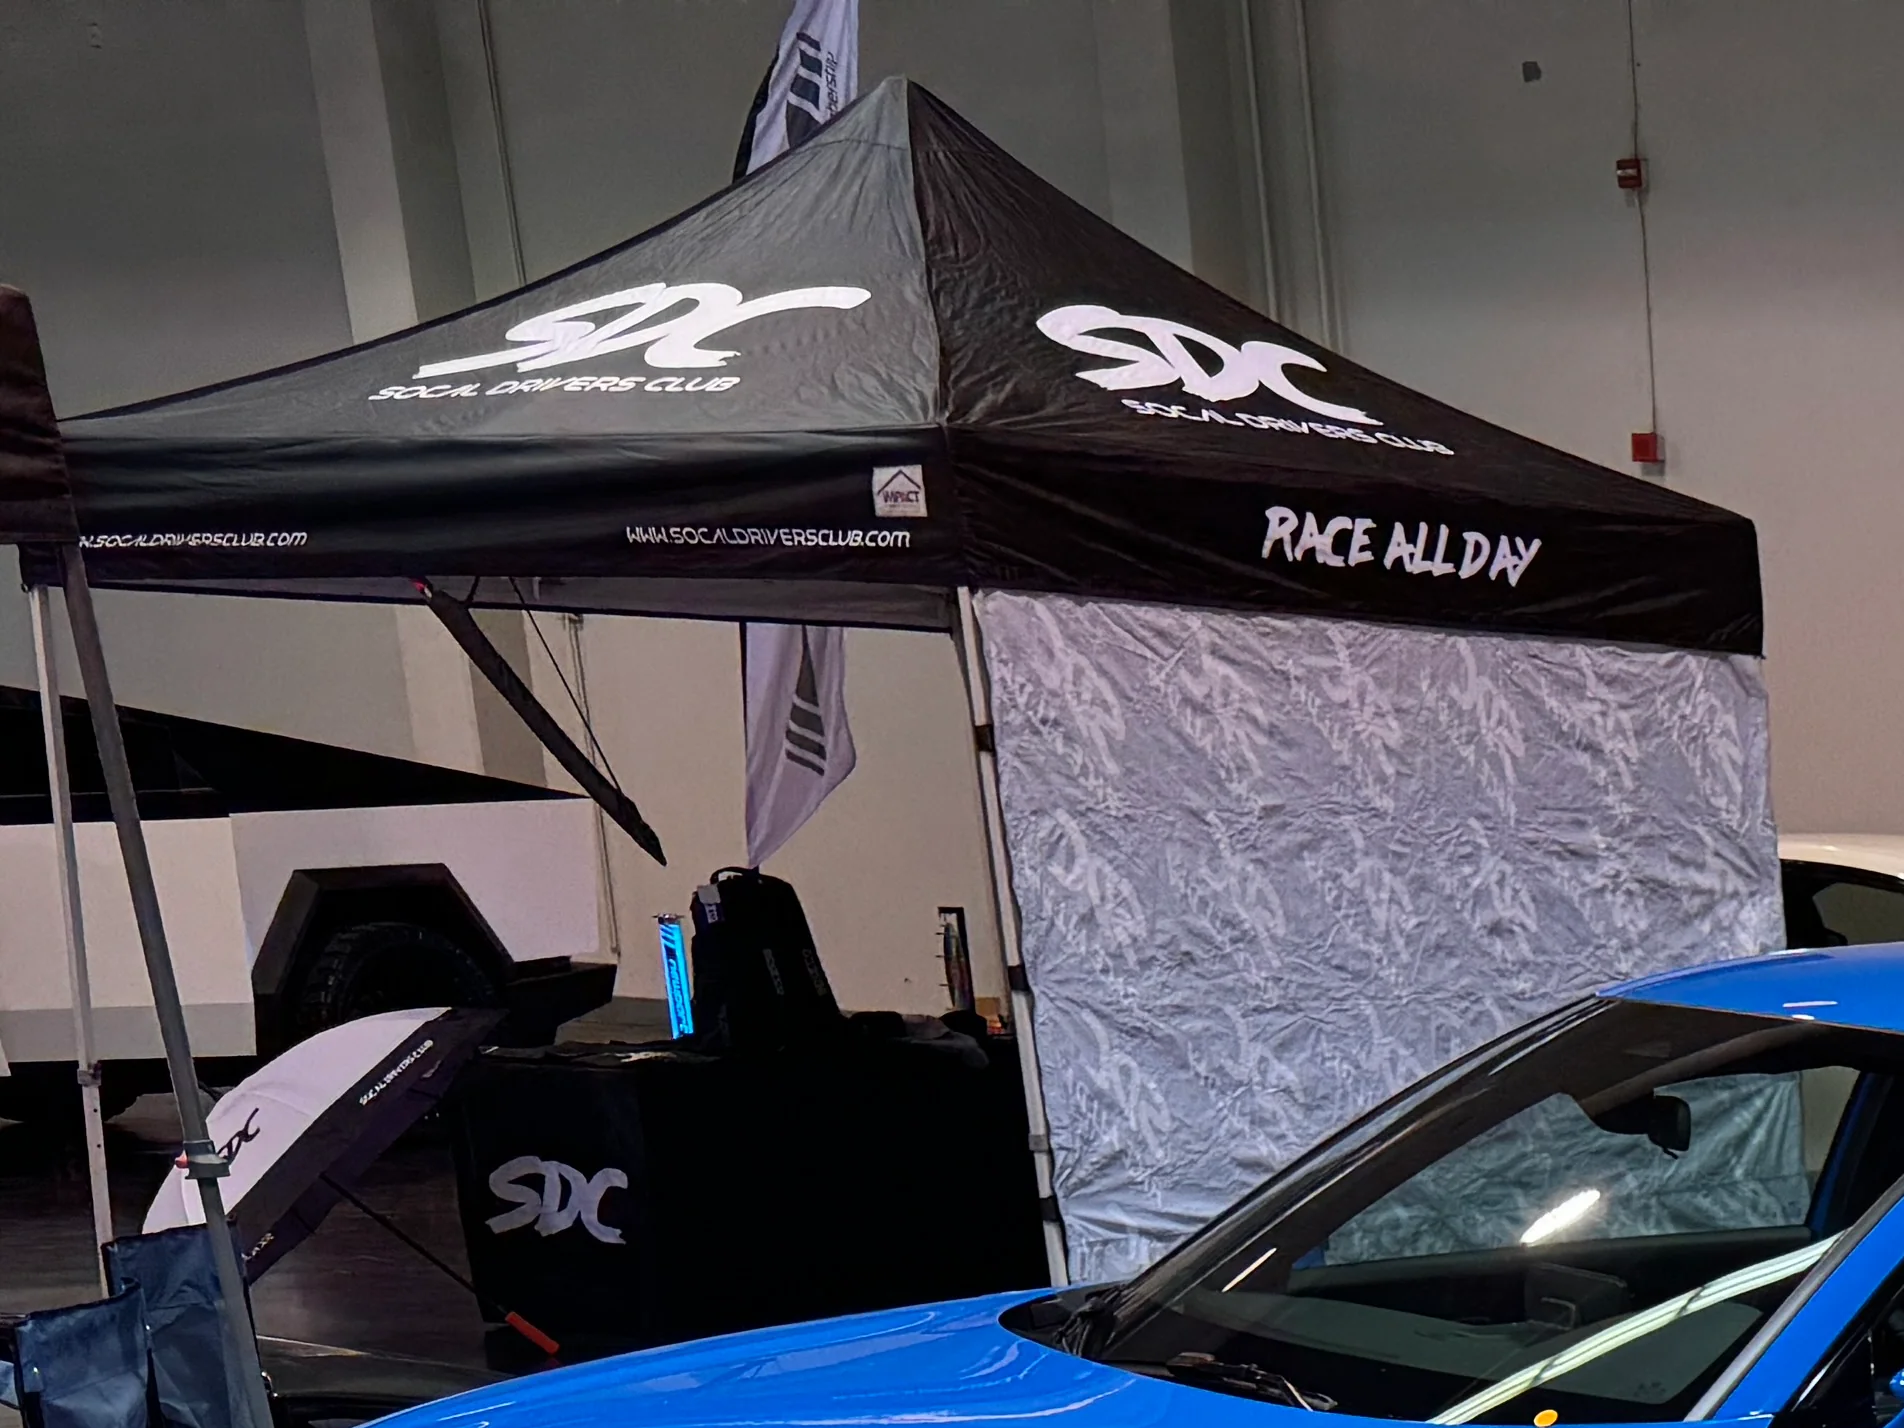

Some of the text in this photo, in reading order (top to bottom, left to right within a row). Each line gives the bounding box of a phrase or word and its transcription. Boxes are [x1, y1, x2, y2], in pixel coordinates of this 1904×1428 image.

[413, 283, 872, 379] SDC
[1036, 304, 1384, 426] SDC
[368, 376, 741, 400] SOCAL DRIVERS CLUB
[1121, 398, 1455, 455] SOCAL DRIVERS CLUB
[1261, 506, 1542, 587] RACE ALL DAY
[217, 1107, 261, 1166] DC
[485, 1155, 629, 1245] SDC
